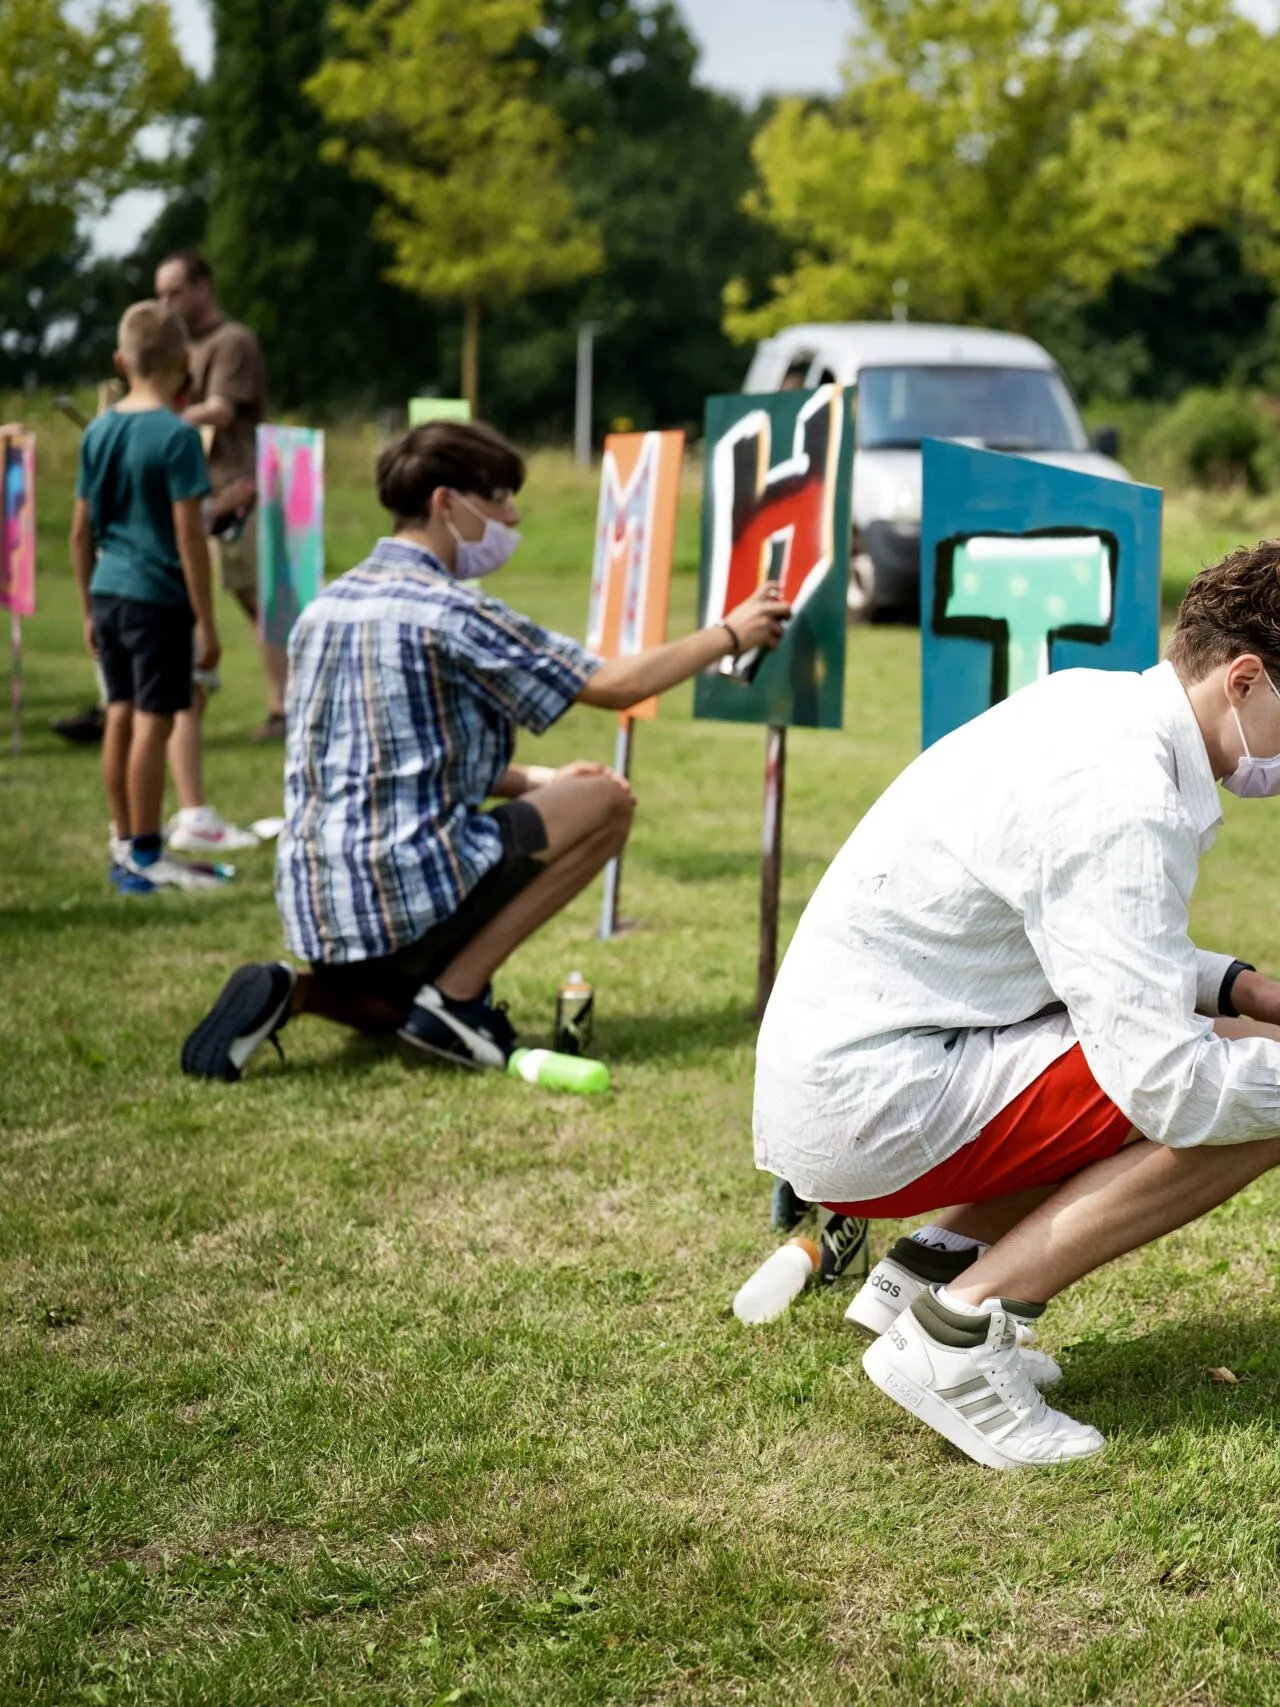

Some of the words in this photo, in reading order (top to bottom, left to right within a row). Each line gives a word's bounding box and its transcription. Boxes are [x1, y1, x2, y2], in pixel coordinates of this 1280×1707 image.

[585, 430, 662, 656] M
[932, 526, 1119, 708] T
[871, 1273, 902, 1298] das
